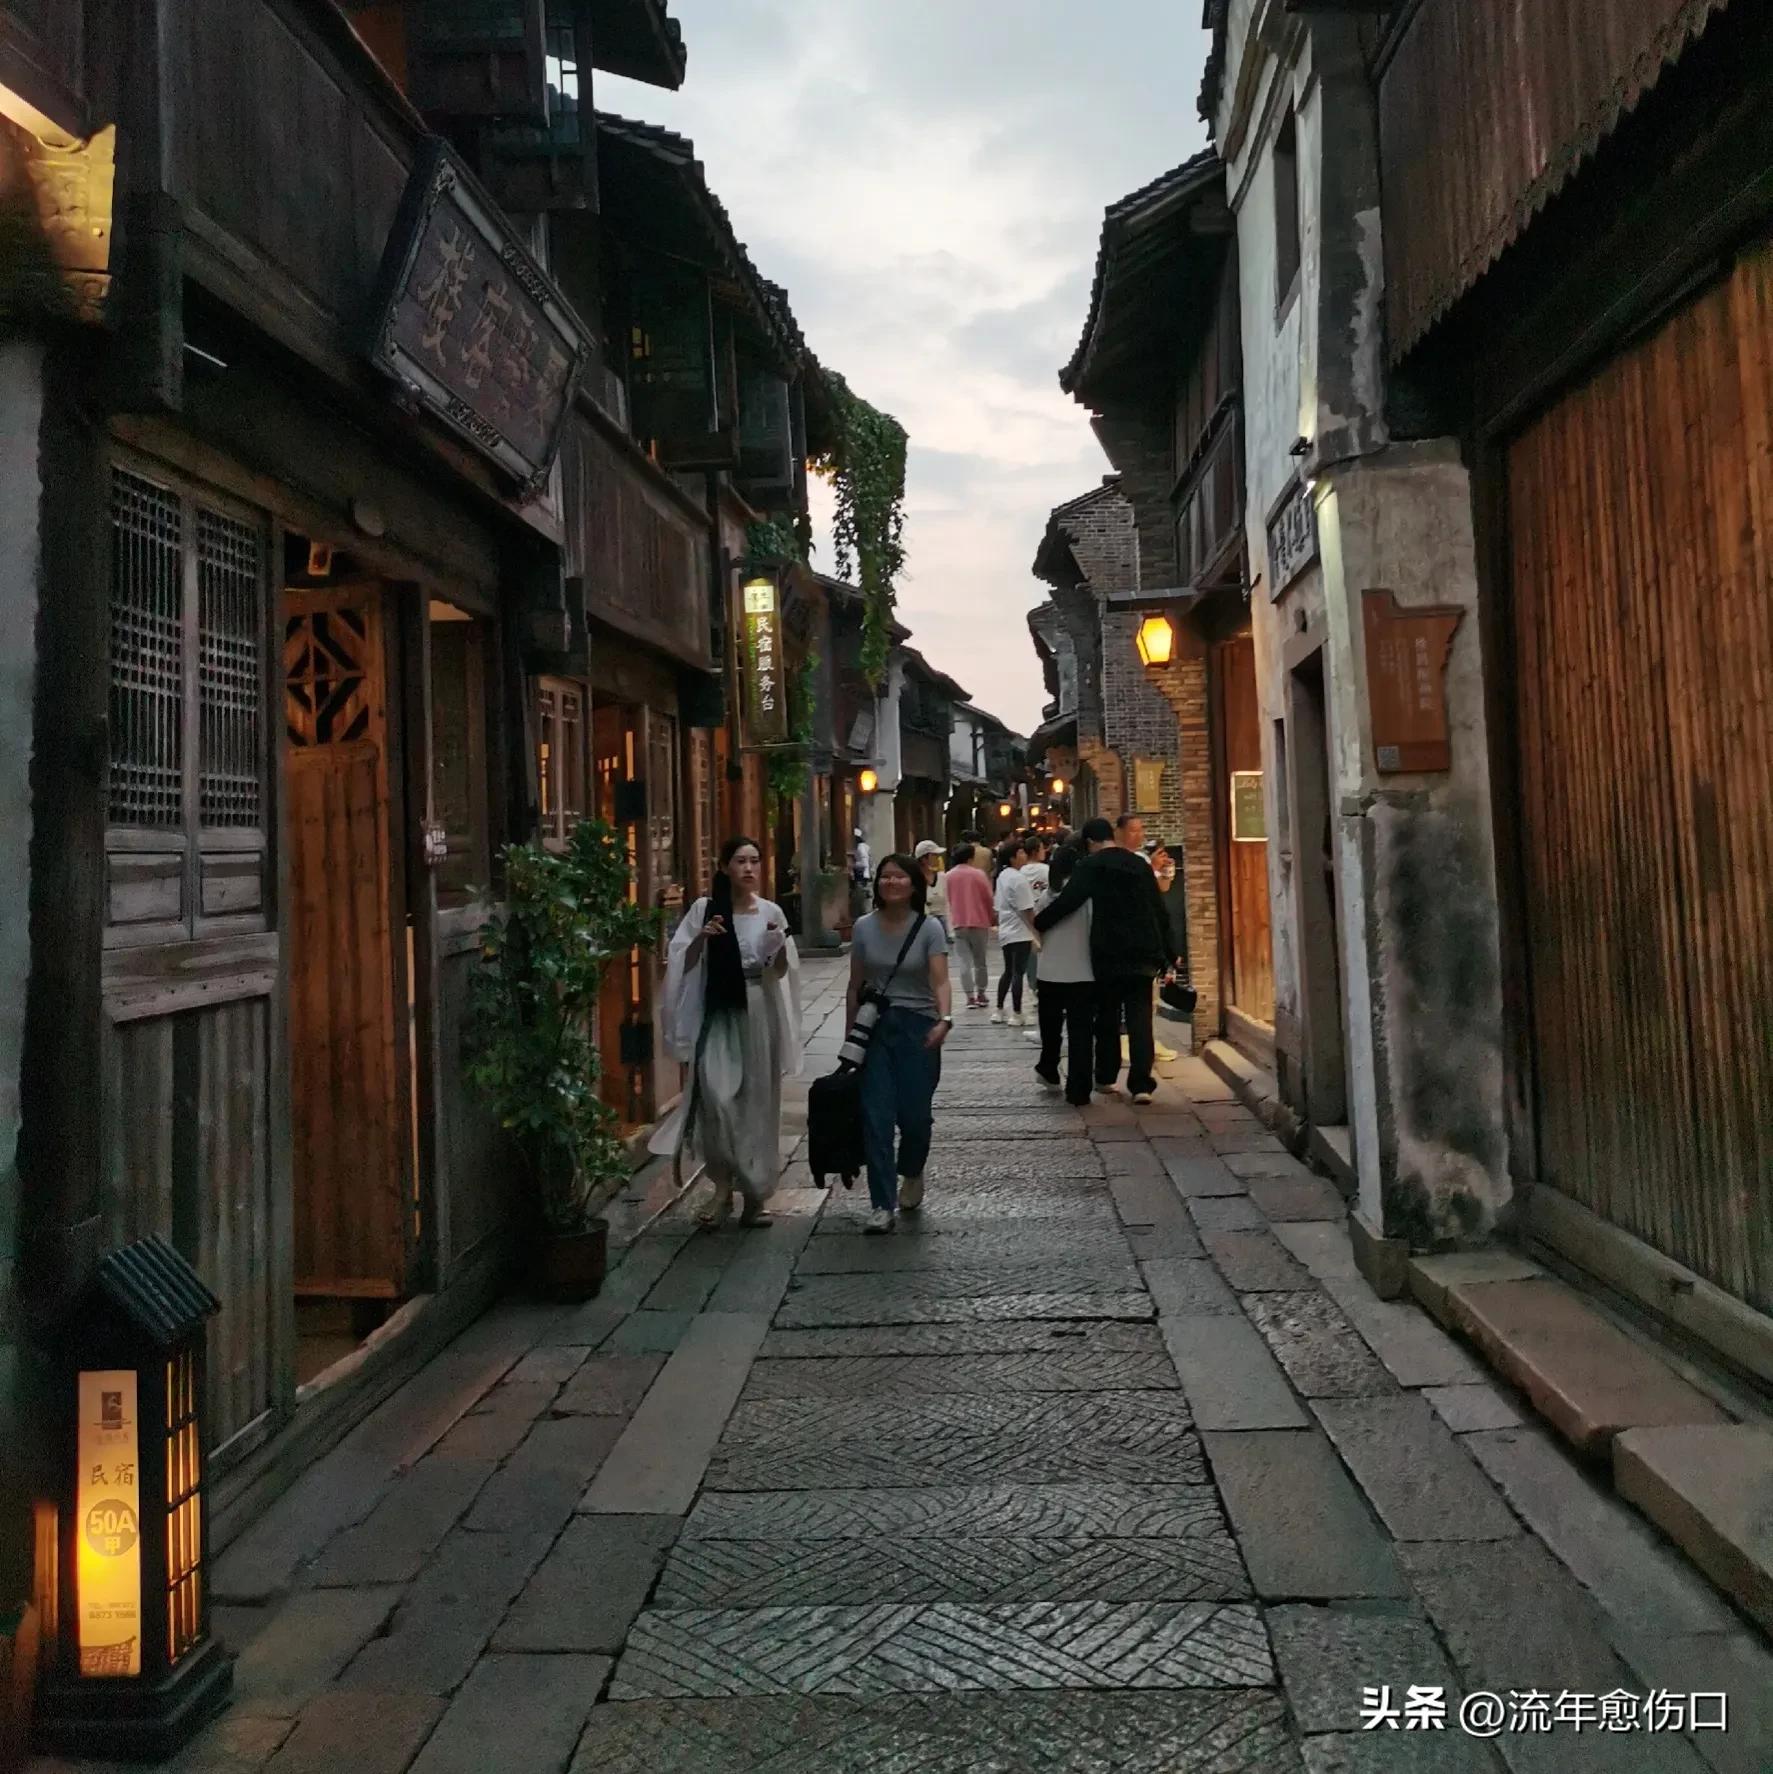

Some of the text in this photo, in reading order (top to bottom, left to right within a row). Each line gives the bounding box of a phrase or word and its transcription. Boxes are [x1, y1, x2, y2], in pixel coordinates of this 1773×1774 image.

[757, 616, 775, 711] 民宿服务台
[91, 1463, 134, 1486] 民宿
[90, 1510, 136, 1534] 50A
[104, 1536, 120, 1554] 甲
